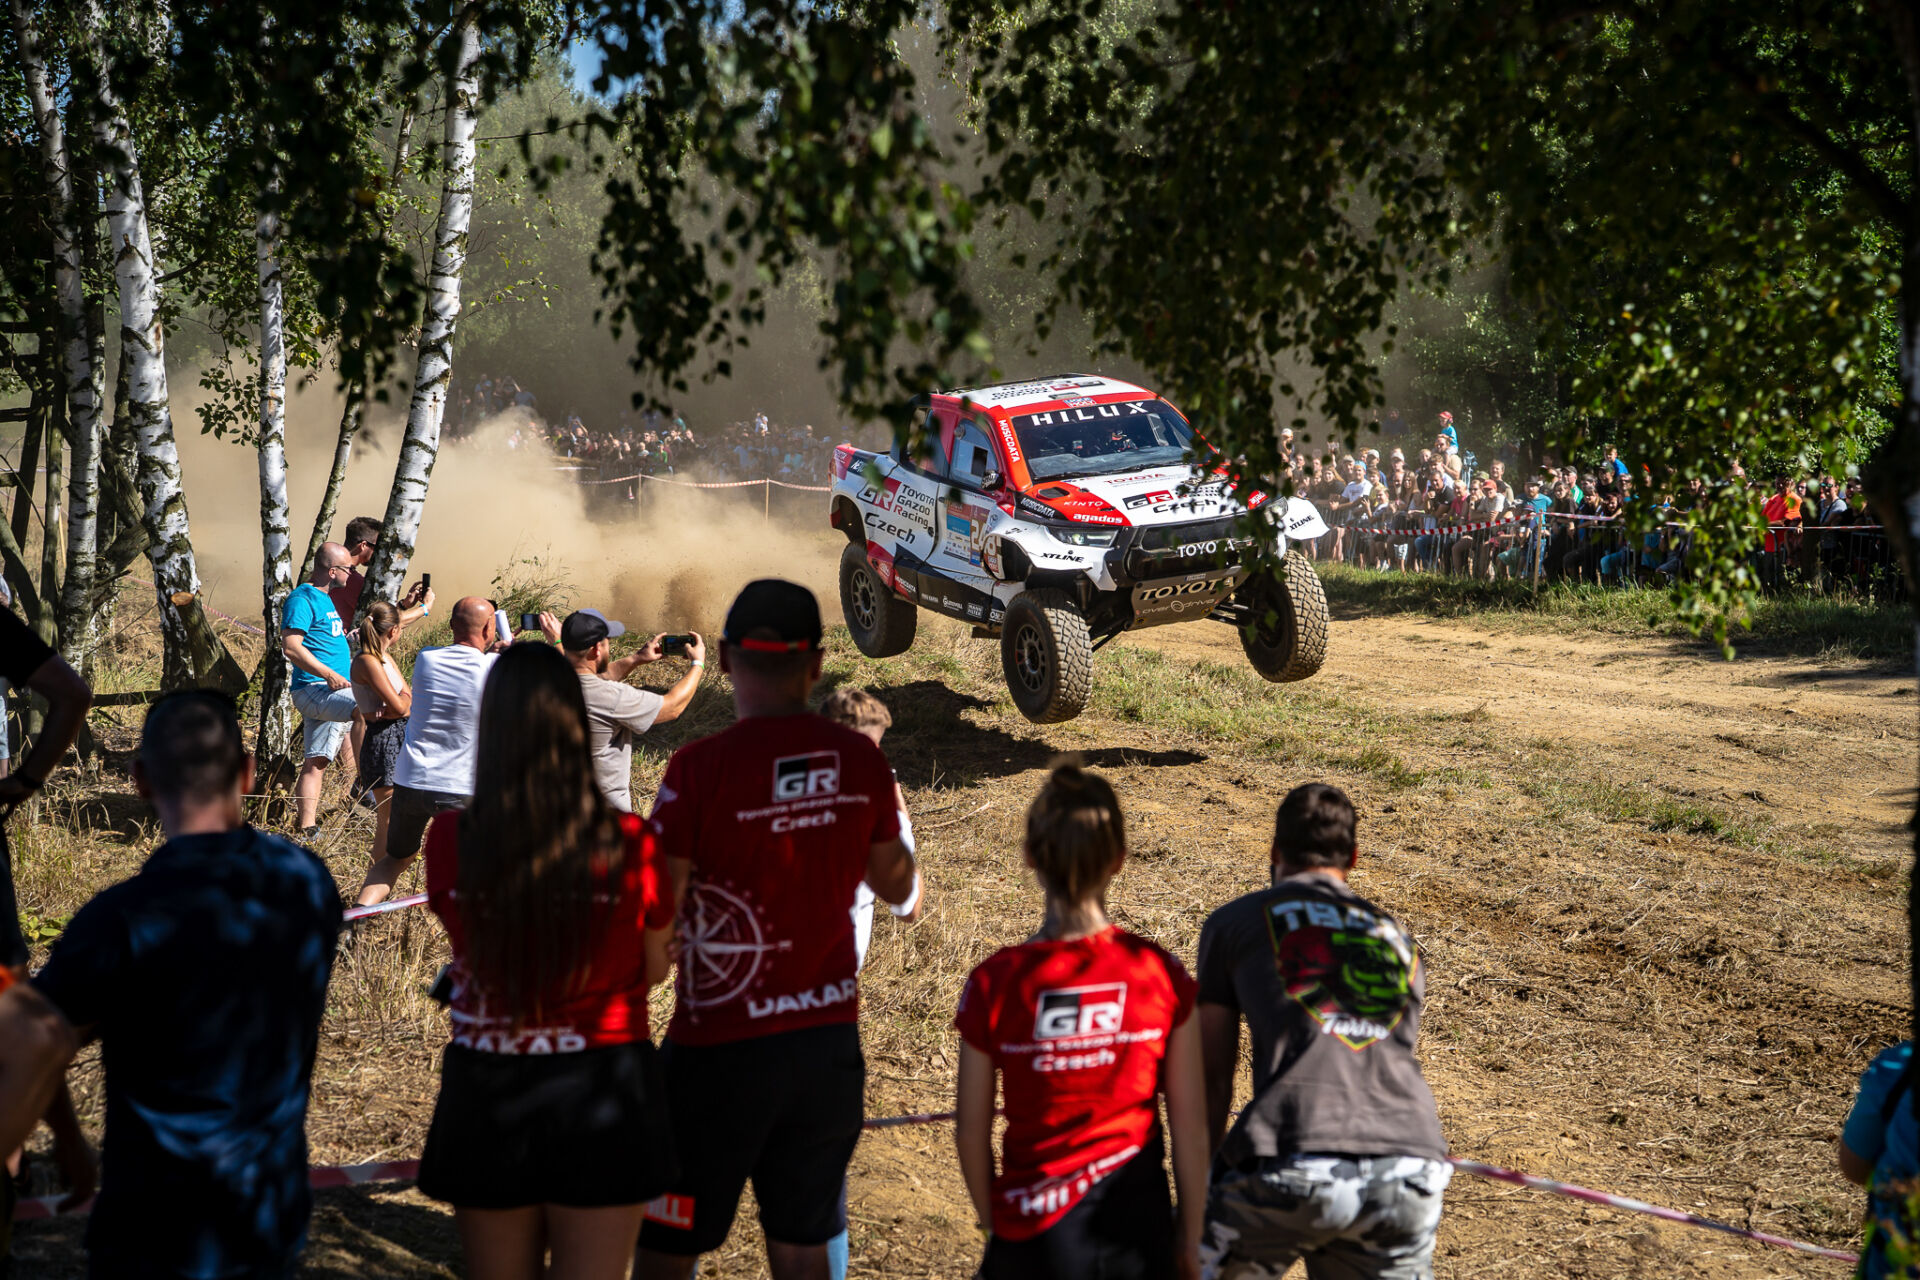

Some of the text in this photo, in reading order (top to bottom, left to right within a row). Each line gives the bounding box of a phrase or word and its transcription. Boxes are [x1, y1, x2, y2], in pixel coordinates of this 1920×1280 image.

[1031, 401, 1150, 427] HILUX
[998, 419, 1021, 463] MUSICDATA
[1103, 473, 1166, 485] TOYOTA
[896, 494, 931, 517] GAZOO
[902, 484, 935, 507] TOYOTA
[1125, 492, 1173, 511] GR
[893, 505, 929, 530] Racing
[1020, 497, 1056, 519] MUSICDATA
[1073, 513, 1123, 524] agados
[864, 511, 916, 545] Czech
[1040, 551, 1086, 563] XTLINE
[1178, 538, 1236, 558] TOYOA
[777, 768, 837, 798] GR
[770, 809, 837, 833] Czech
[1039, 1001, 1122, 1037] GR
[1032, 1047, 1118, 1073] Czech
